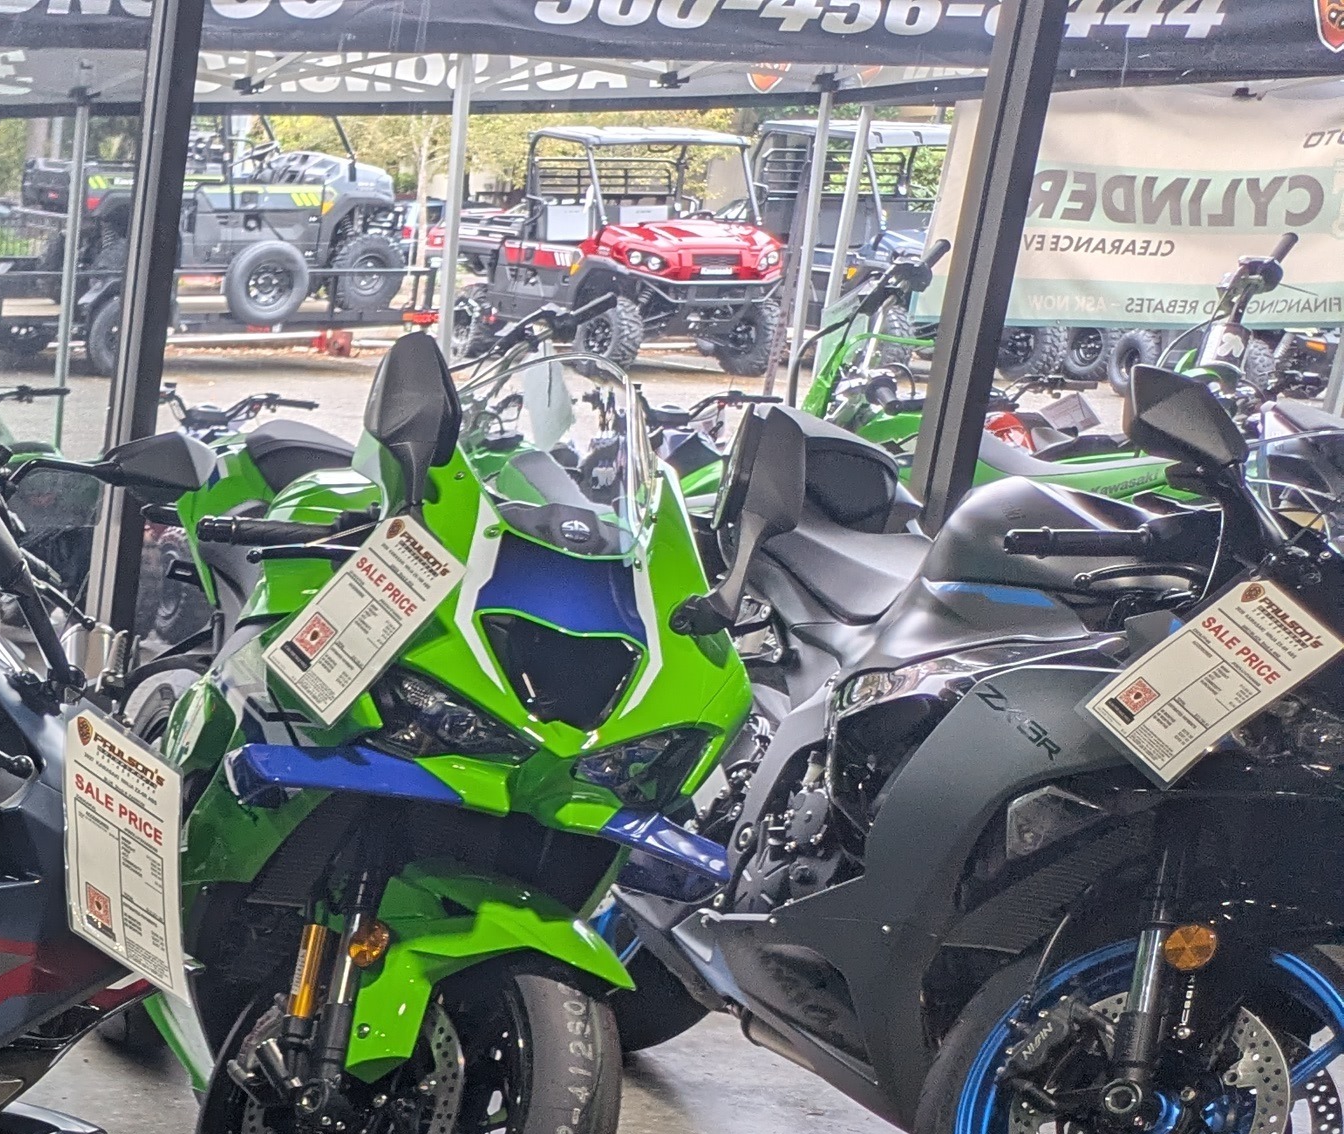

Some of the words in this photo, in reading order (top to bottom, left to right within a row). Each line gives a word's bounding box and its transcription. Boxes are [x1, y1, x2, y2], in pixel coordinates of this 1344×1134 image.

[356, 557, 387, 587] SALE
[382, 582, 418, 617] PRICE
[1201, 616, 1241, 650] SALE
[1235, 646, 1281, 685] PRICE
[75, 774, 114, 812] SALE
[119, 804, 163, 846] PRICE
